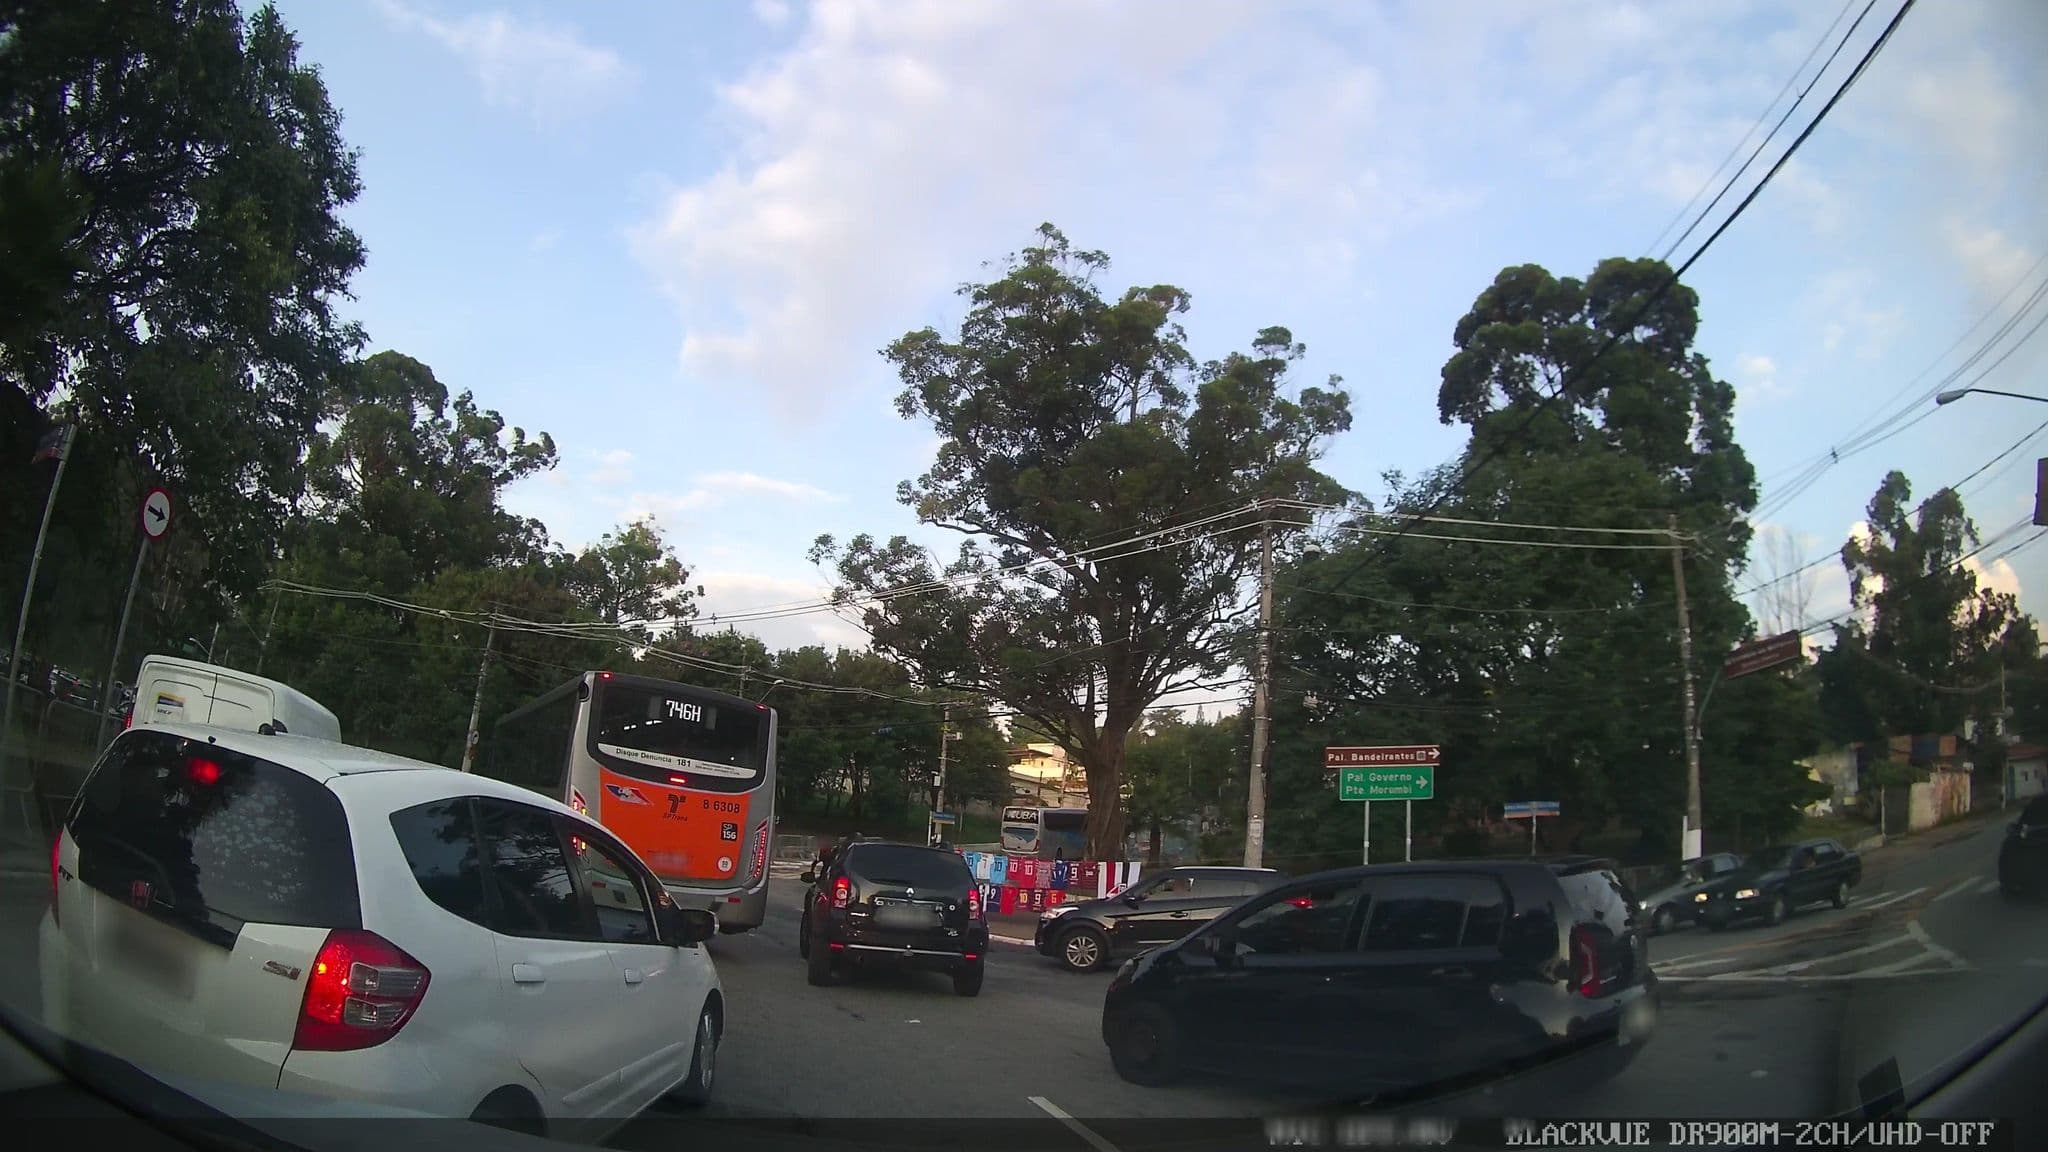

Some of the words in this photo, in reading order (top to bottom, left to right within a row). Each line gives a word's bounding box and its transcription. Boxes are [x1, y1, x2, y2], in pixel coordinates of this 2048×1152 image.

[665, 700, 702, 722] 746H
[616, 748, 639, 758] Disque
[677, 758, 691, 767] 181
[1351, 752, 1415, 761] Bandeirantes
[1369, 773, 1412, 782] Governo
[1370, 785, 1412, 794] Morumbi
[713, 800, 740, 813] 6308
[723, 830, 737, 840] 156
[1009, 861, 1018, 873] 10
[1024, 864, 1033, 876] 10
[1071, 867, 1078, 879] 9
[1019, 891, 1028, 903] 10
[1034, 893, 1041, 905] 9
